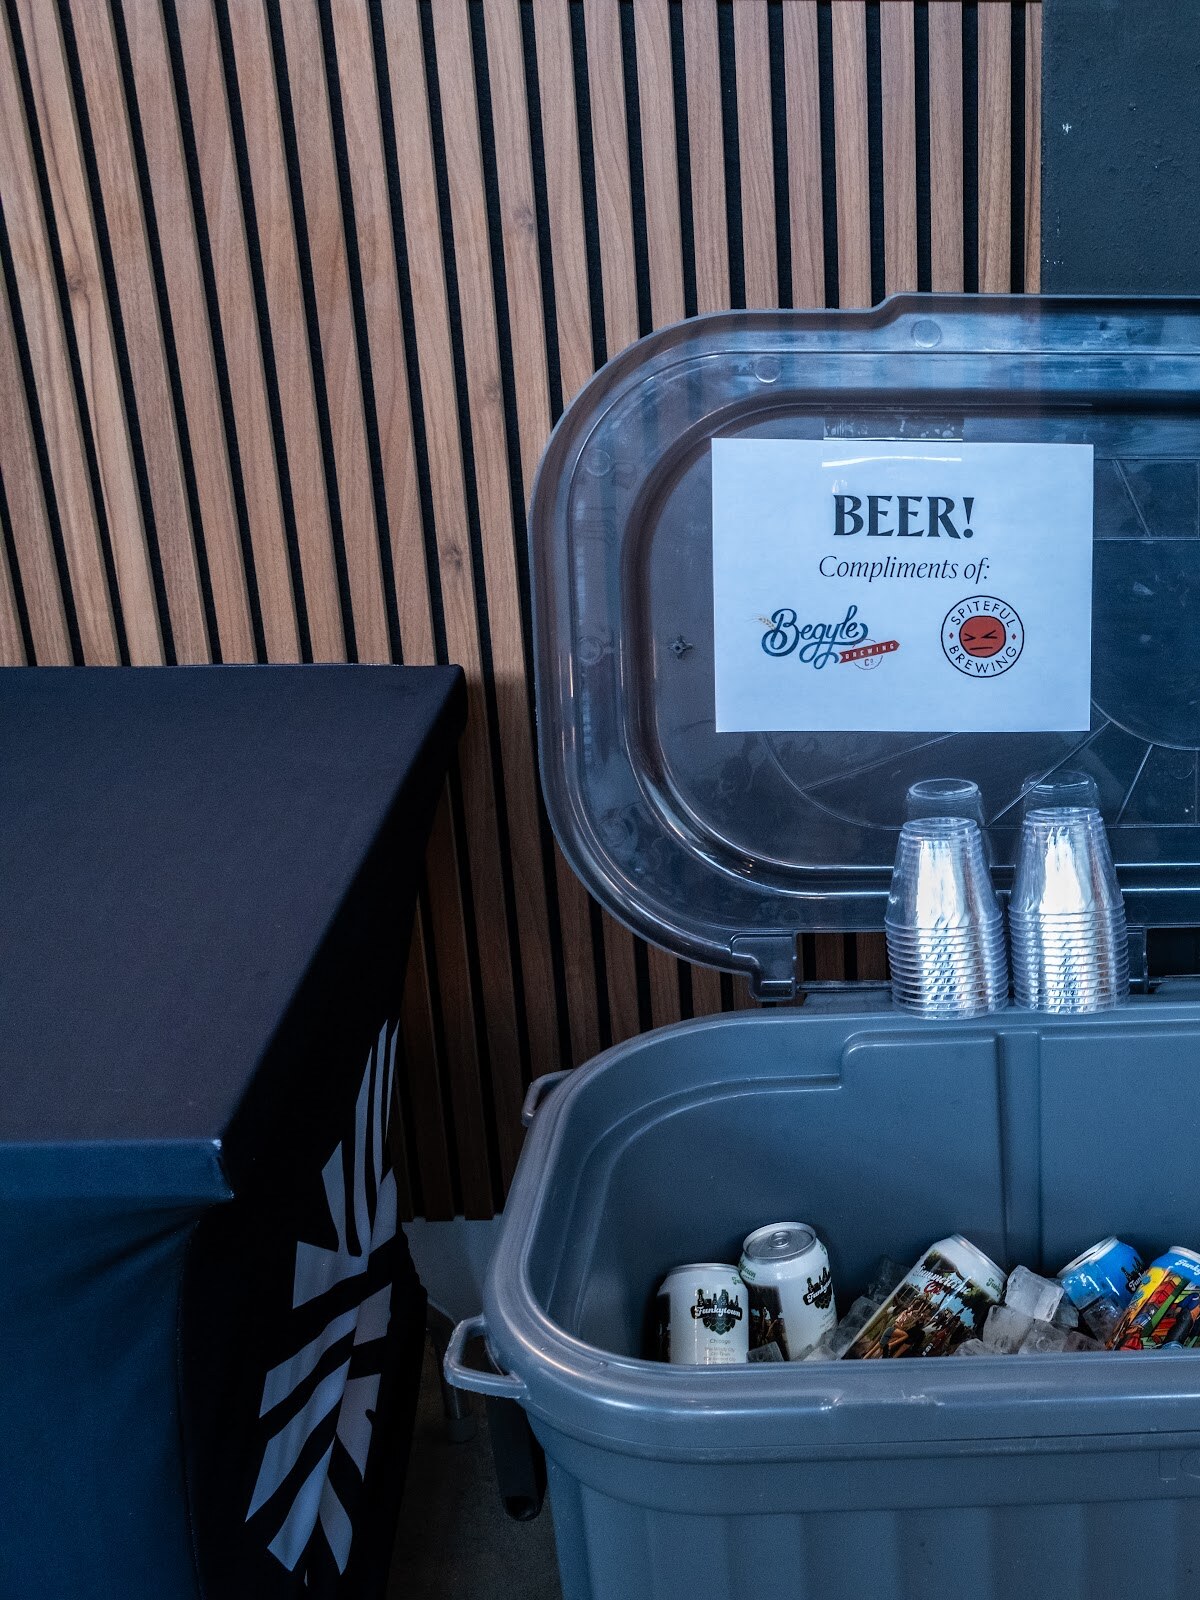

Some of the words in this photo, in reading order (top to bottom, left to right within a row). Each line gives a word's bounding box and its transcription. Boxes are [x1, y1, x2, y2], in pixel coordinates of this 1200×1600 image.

[833, 494, 975, 539] BEER!
[818, 555, 958, 583] Compliments
[963, 557, 991, 584] of:
[951, 600, 1016, 628] SPITEFUL
[761, 604, 869, 670] Begyle
[845, 643, 894, 660] BREWING
[949, 645, 1017, 674] BREWING
[695, 1304, 741, 1317] Funkytown
